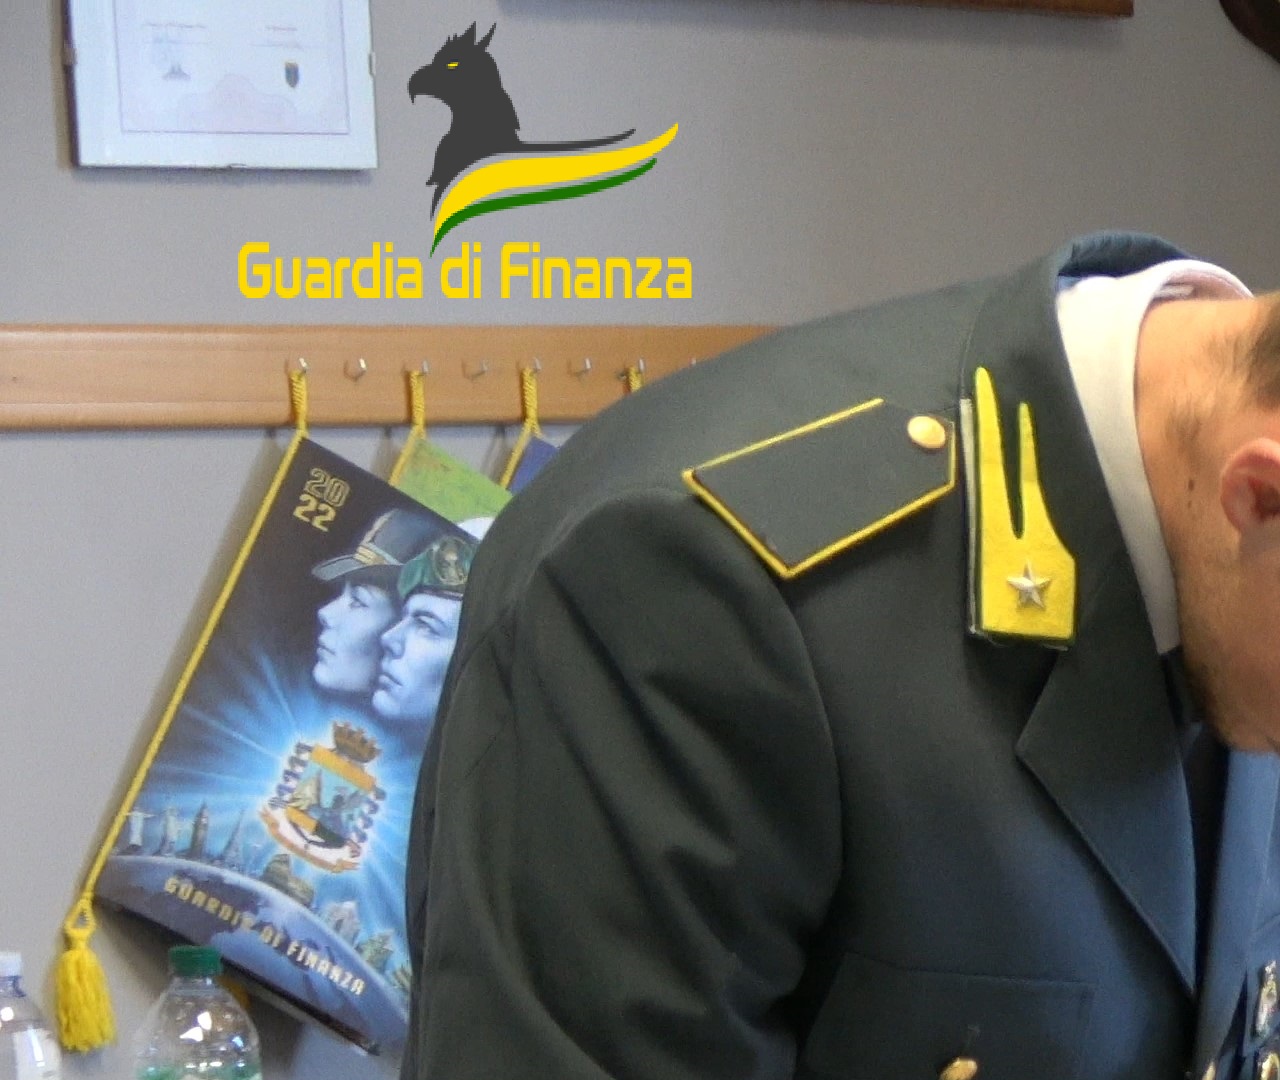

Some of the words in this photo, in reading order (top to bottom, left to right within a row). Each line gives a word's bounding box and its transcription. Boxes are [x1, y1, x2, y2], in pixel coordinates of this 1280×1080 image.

[304, 467, 351, 507] 20
[293, 493, 336, 532] 22
[287, 940, 366, 996] FINANZA
